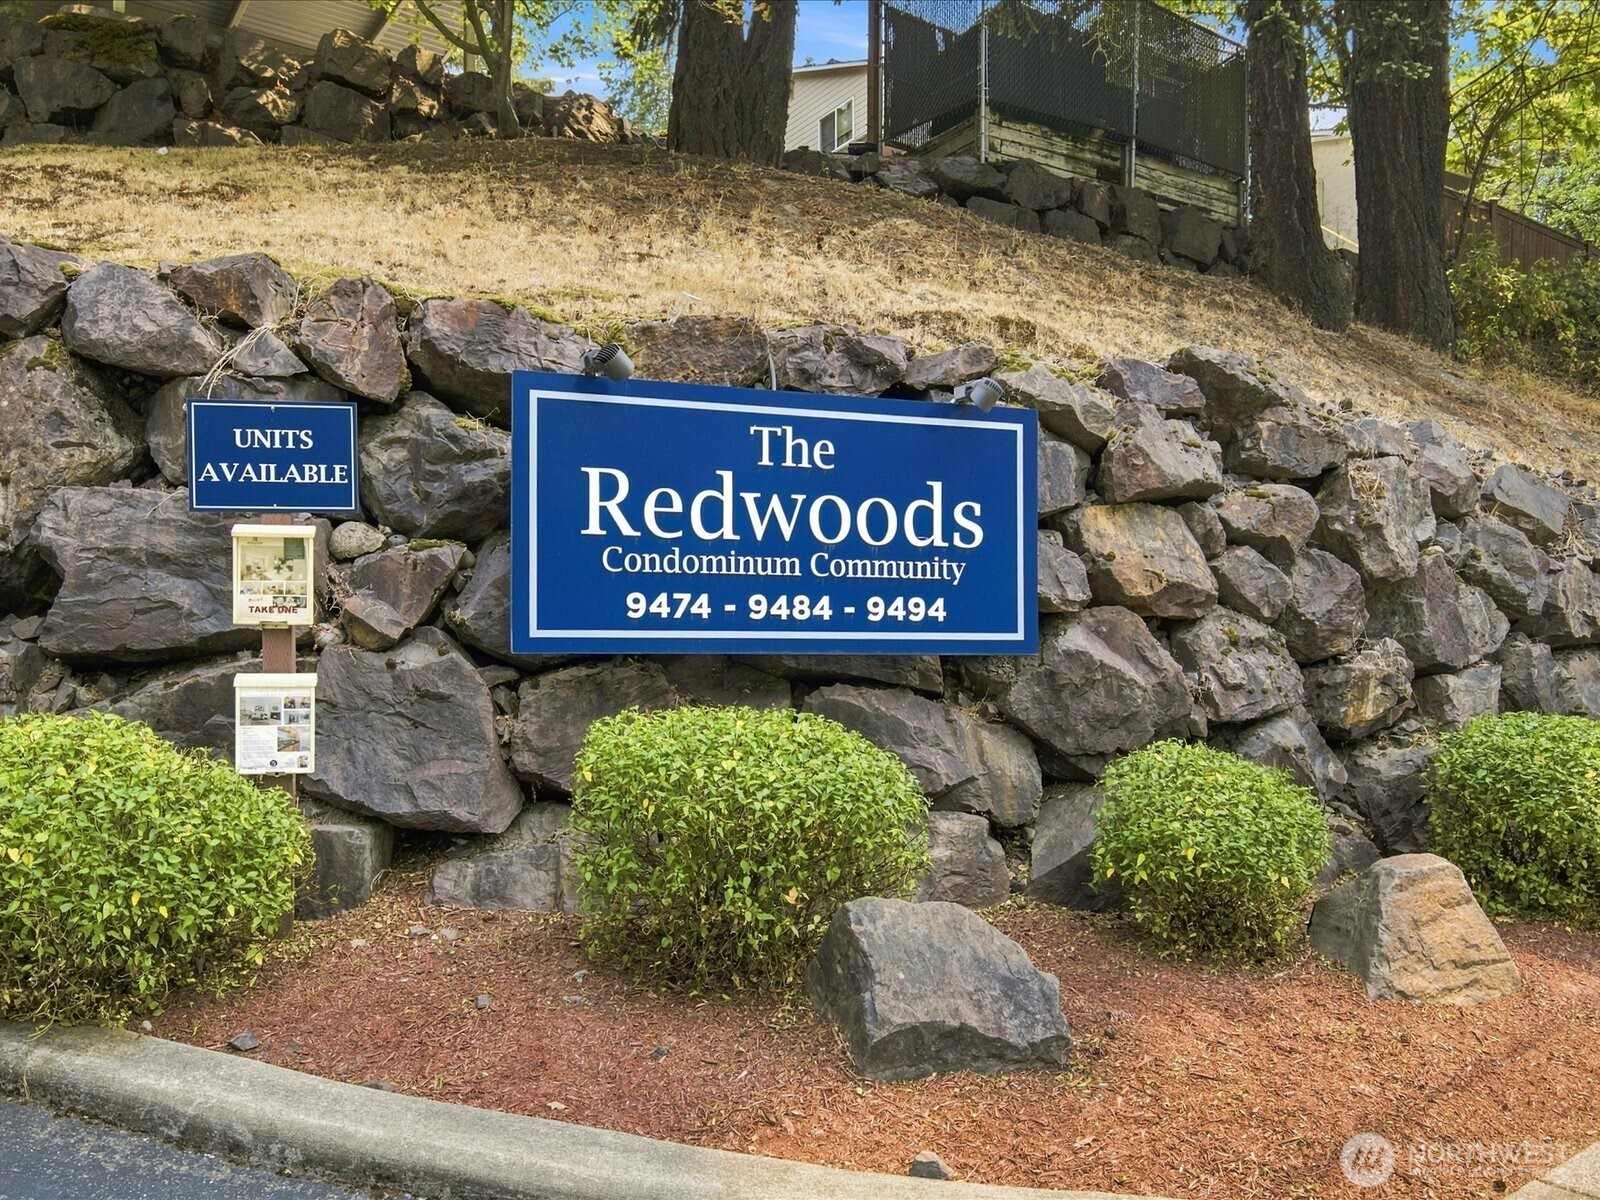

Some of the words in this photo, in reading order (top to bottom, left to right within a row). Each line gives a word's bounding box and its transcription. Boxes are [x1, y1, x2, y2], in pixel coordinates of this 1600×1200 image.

[233, 428, 314, 450] UNITS
[750, 425, 836, 470] The
[198, 462, 349, 484] AVAILABLE
[580, 466, 985, 549] Redwoods
[602, 545, 802, 577] Condominum
[810, 552, 967, 586] Community
[248, 605, 275, 614] TAKE
[277, 605, 298, 614] ONE
[625, 591, 712, 619] 9474
[748, 594, 833, 621] 9484
[866, 596, 947, 622] 9494
